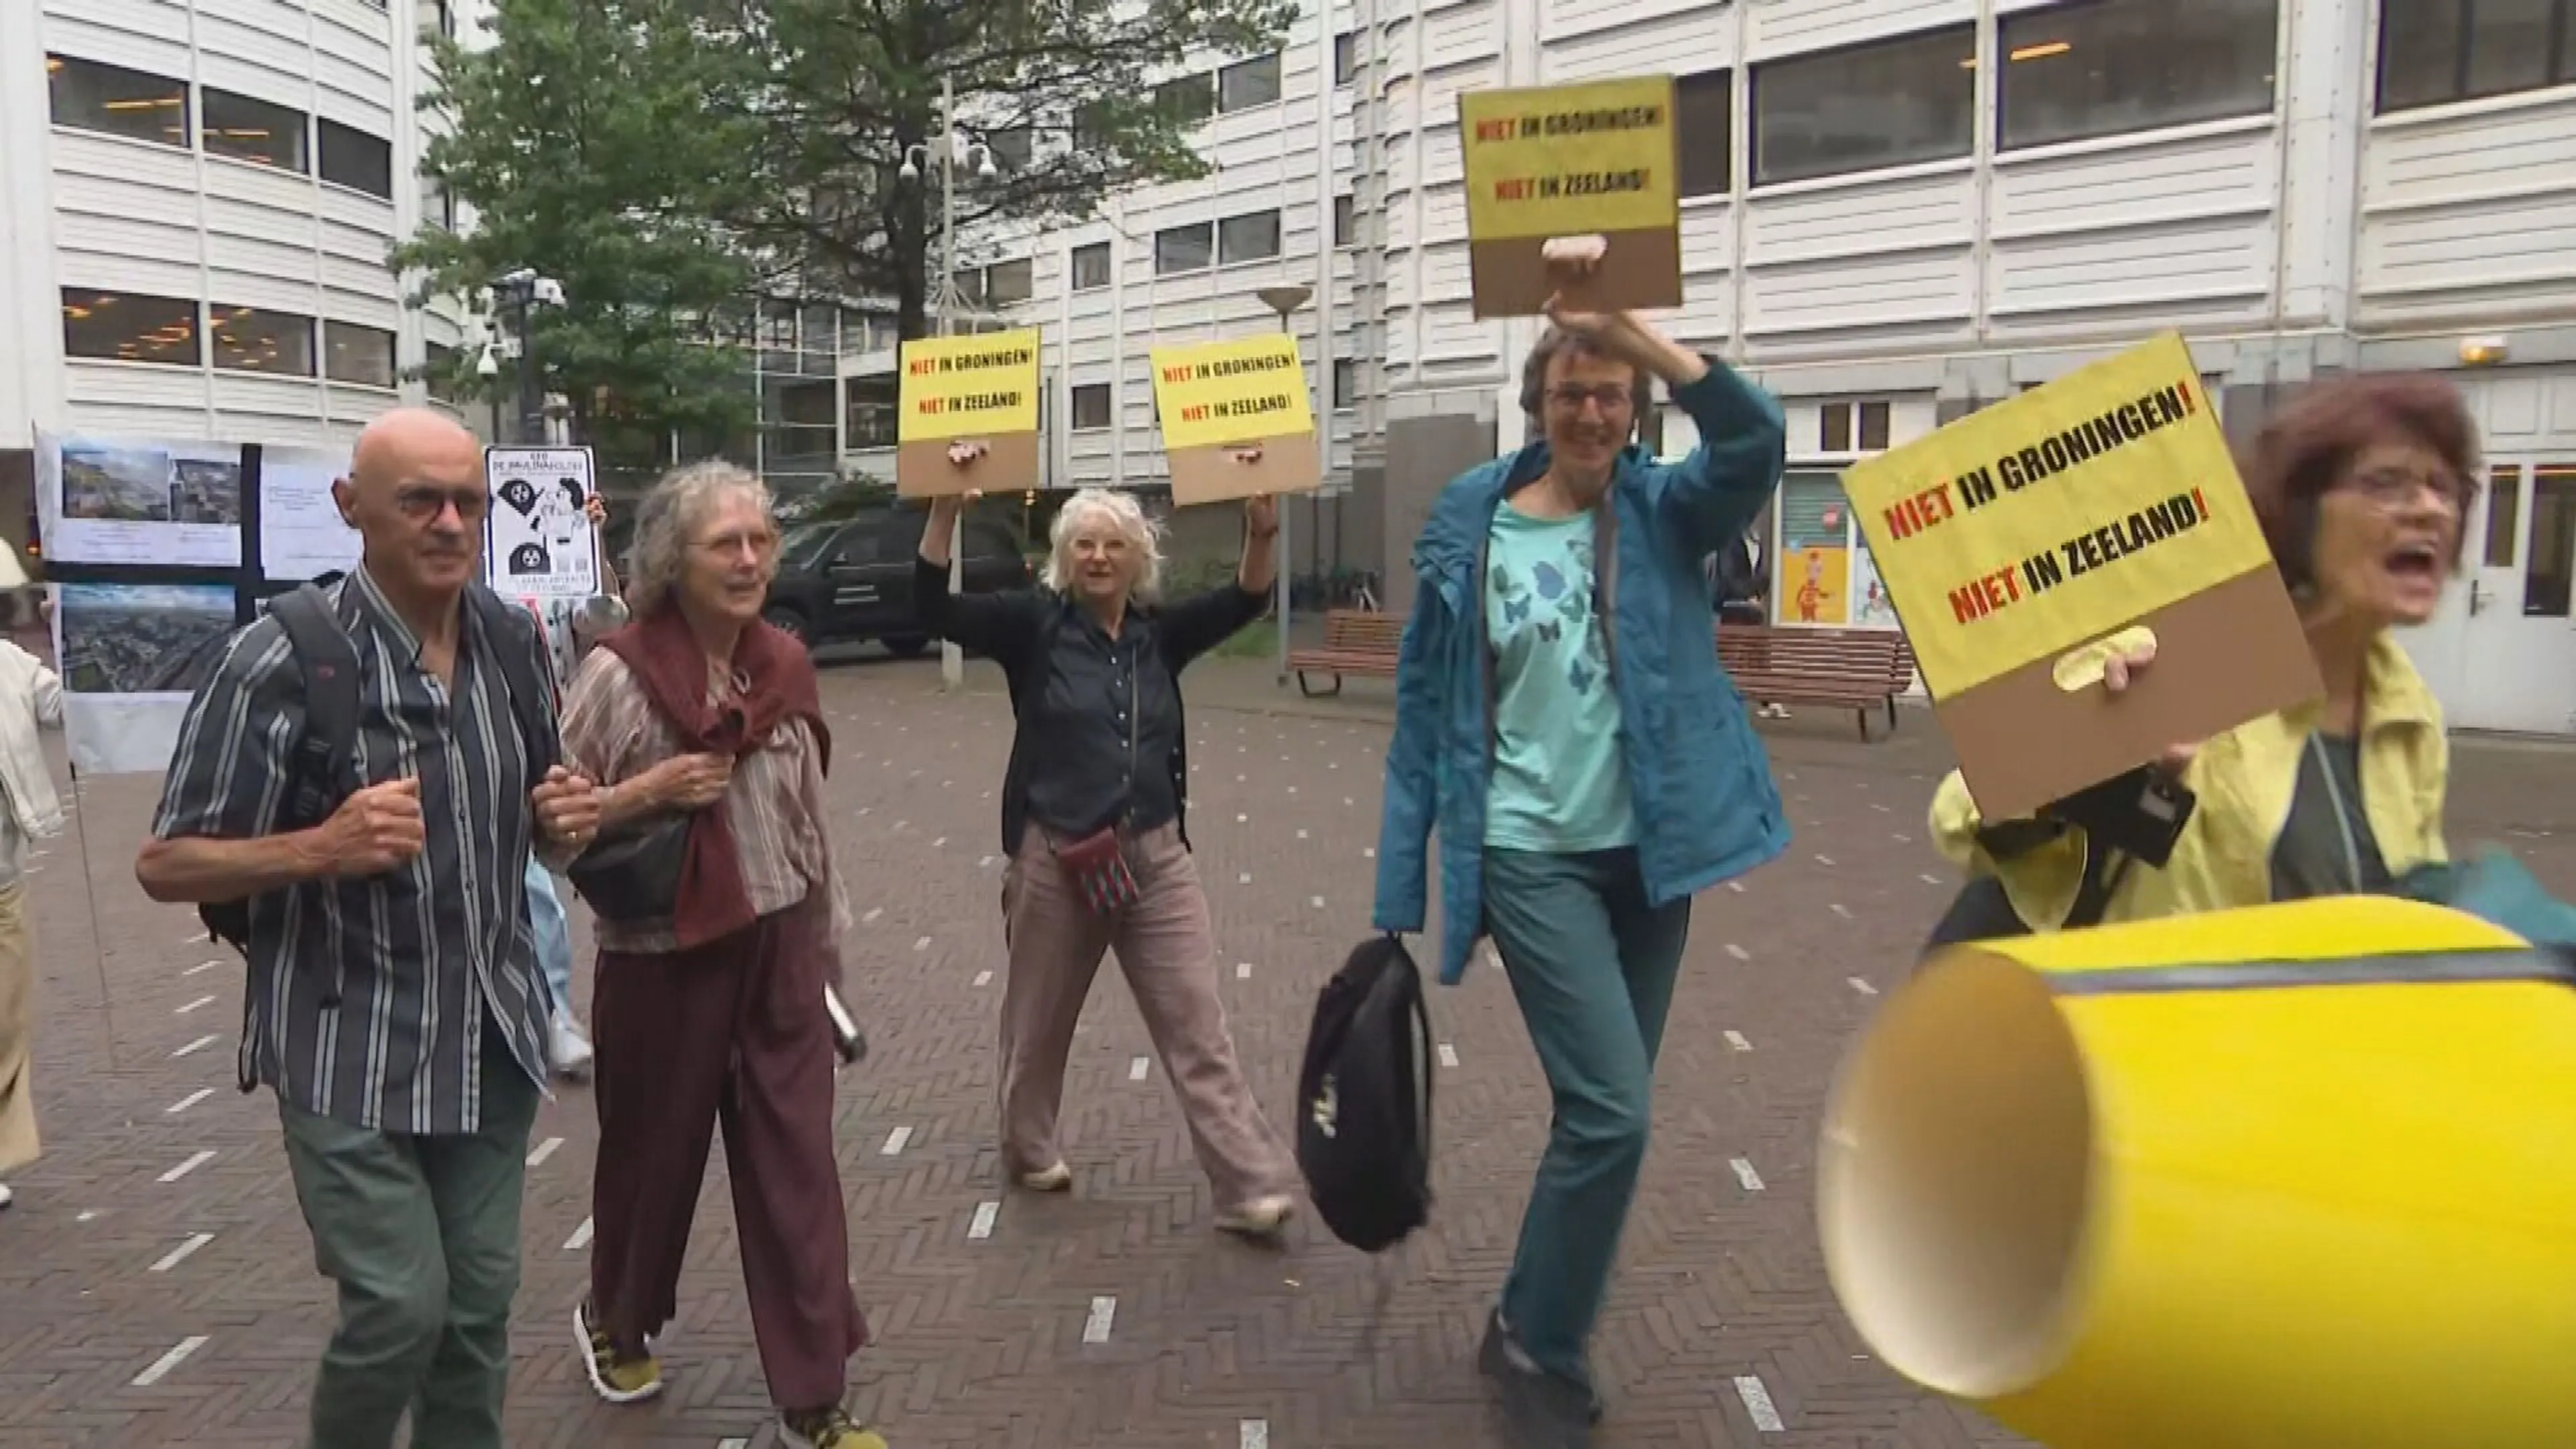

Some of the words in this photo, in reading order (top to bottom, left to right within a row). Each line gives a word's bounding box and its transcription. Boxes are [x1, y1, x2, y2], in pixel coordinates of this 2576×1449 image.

[1476, 117, 1515, 144] NIET
[1521, 117, 1540, 139] IN
[1495, 177, 1535, 201] NIET
[1540, 176, 1559, 197] IN
[909, 357, 935, 376] NIET
[939, 356, 952, 372] IN
[955, 348, 1032, 371] GRONINGEN!
[1162, 364, 1191, 382] NIET
[1196, 363, 1210, 379] IN
[1213, 352, 1295, 377] GRONINGEN!
[919, 397, 944, 415] NIET
[949, 396, 961, 413] IN
[964, 391, 1022, 411] ZEELAND!
[1182, 405, 1210, 422] NIET
[1214, 402, 1228, 417] IN
[1232, 393, 1292, 417] ZEELAND!
[1882, 482, 1954, 541] NIET
[1956, 466, 1997, 511] IN
[1997, 380, 2196, 492] GRONINGEN!
[1947, 564, 2020, 625] NIET
[2021, 549, 2062, 594] IN
[2061, 486, 2210, 578] ZEELAND!
